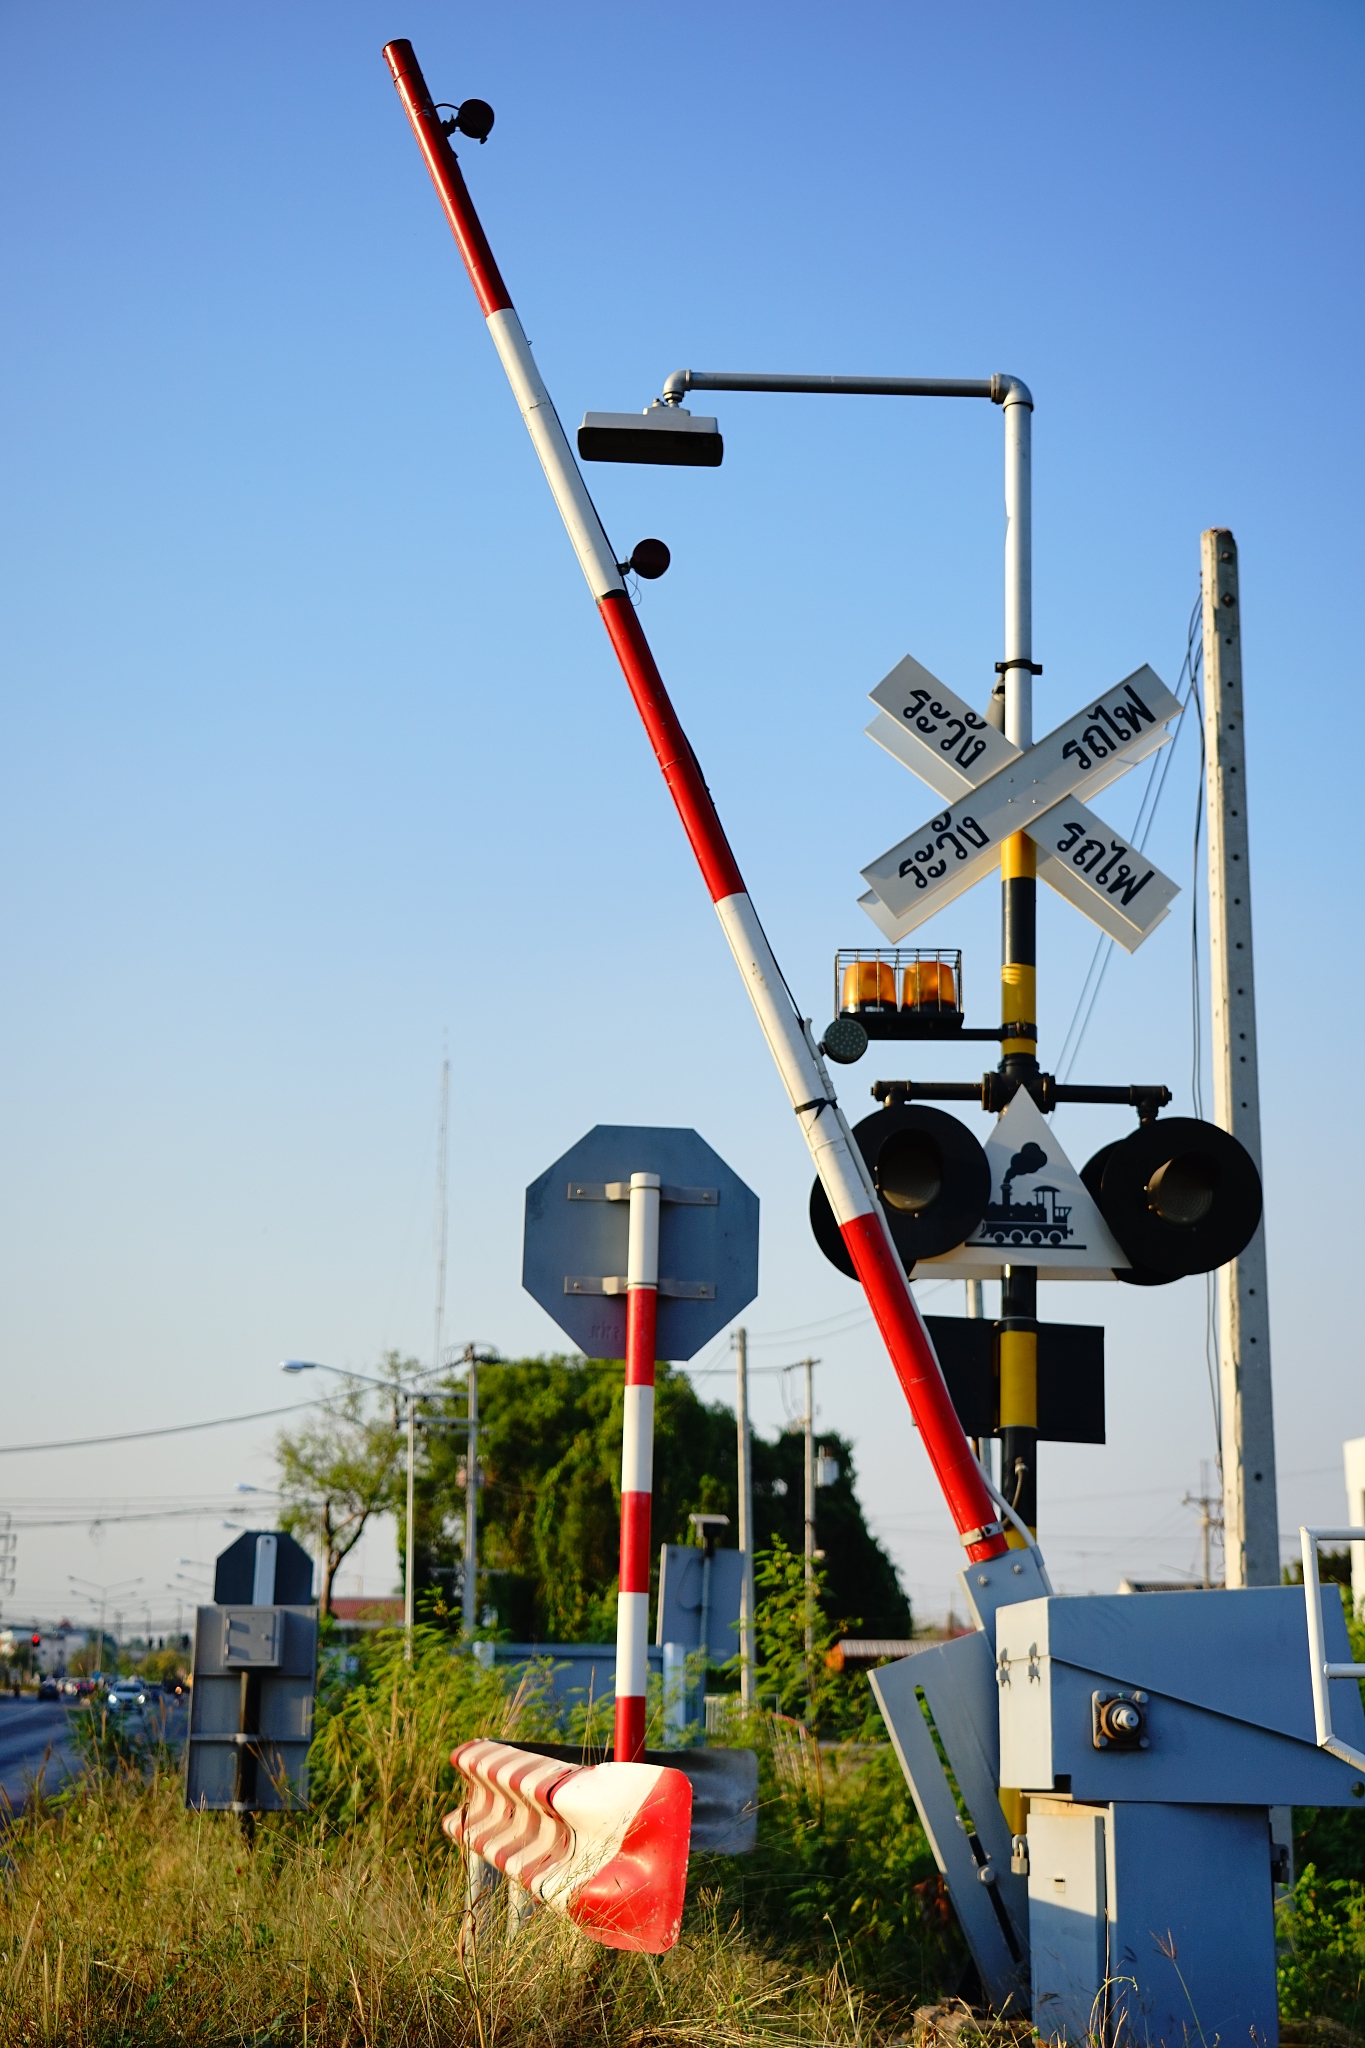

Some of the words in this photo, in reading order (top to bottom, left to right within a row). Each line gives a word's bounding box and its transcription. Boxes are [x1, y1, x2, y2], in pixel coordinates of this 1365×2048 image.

[898, 810, 991, 889] ระวัง
[1062, 684, 1157, 770] รถไฟ
[902, 689, 988, 770] ระวัง
[1056, 822, 1155, 907] รถไฟ
